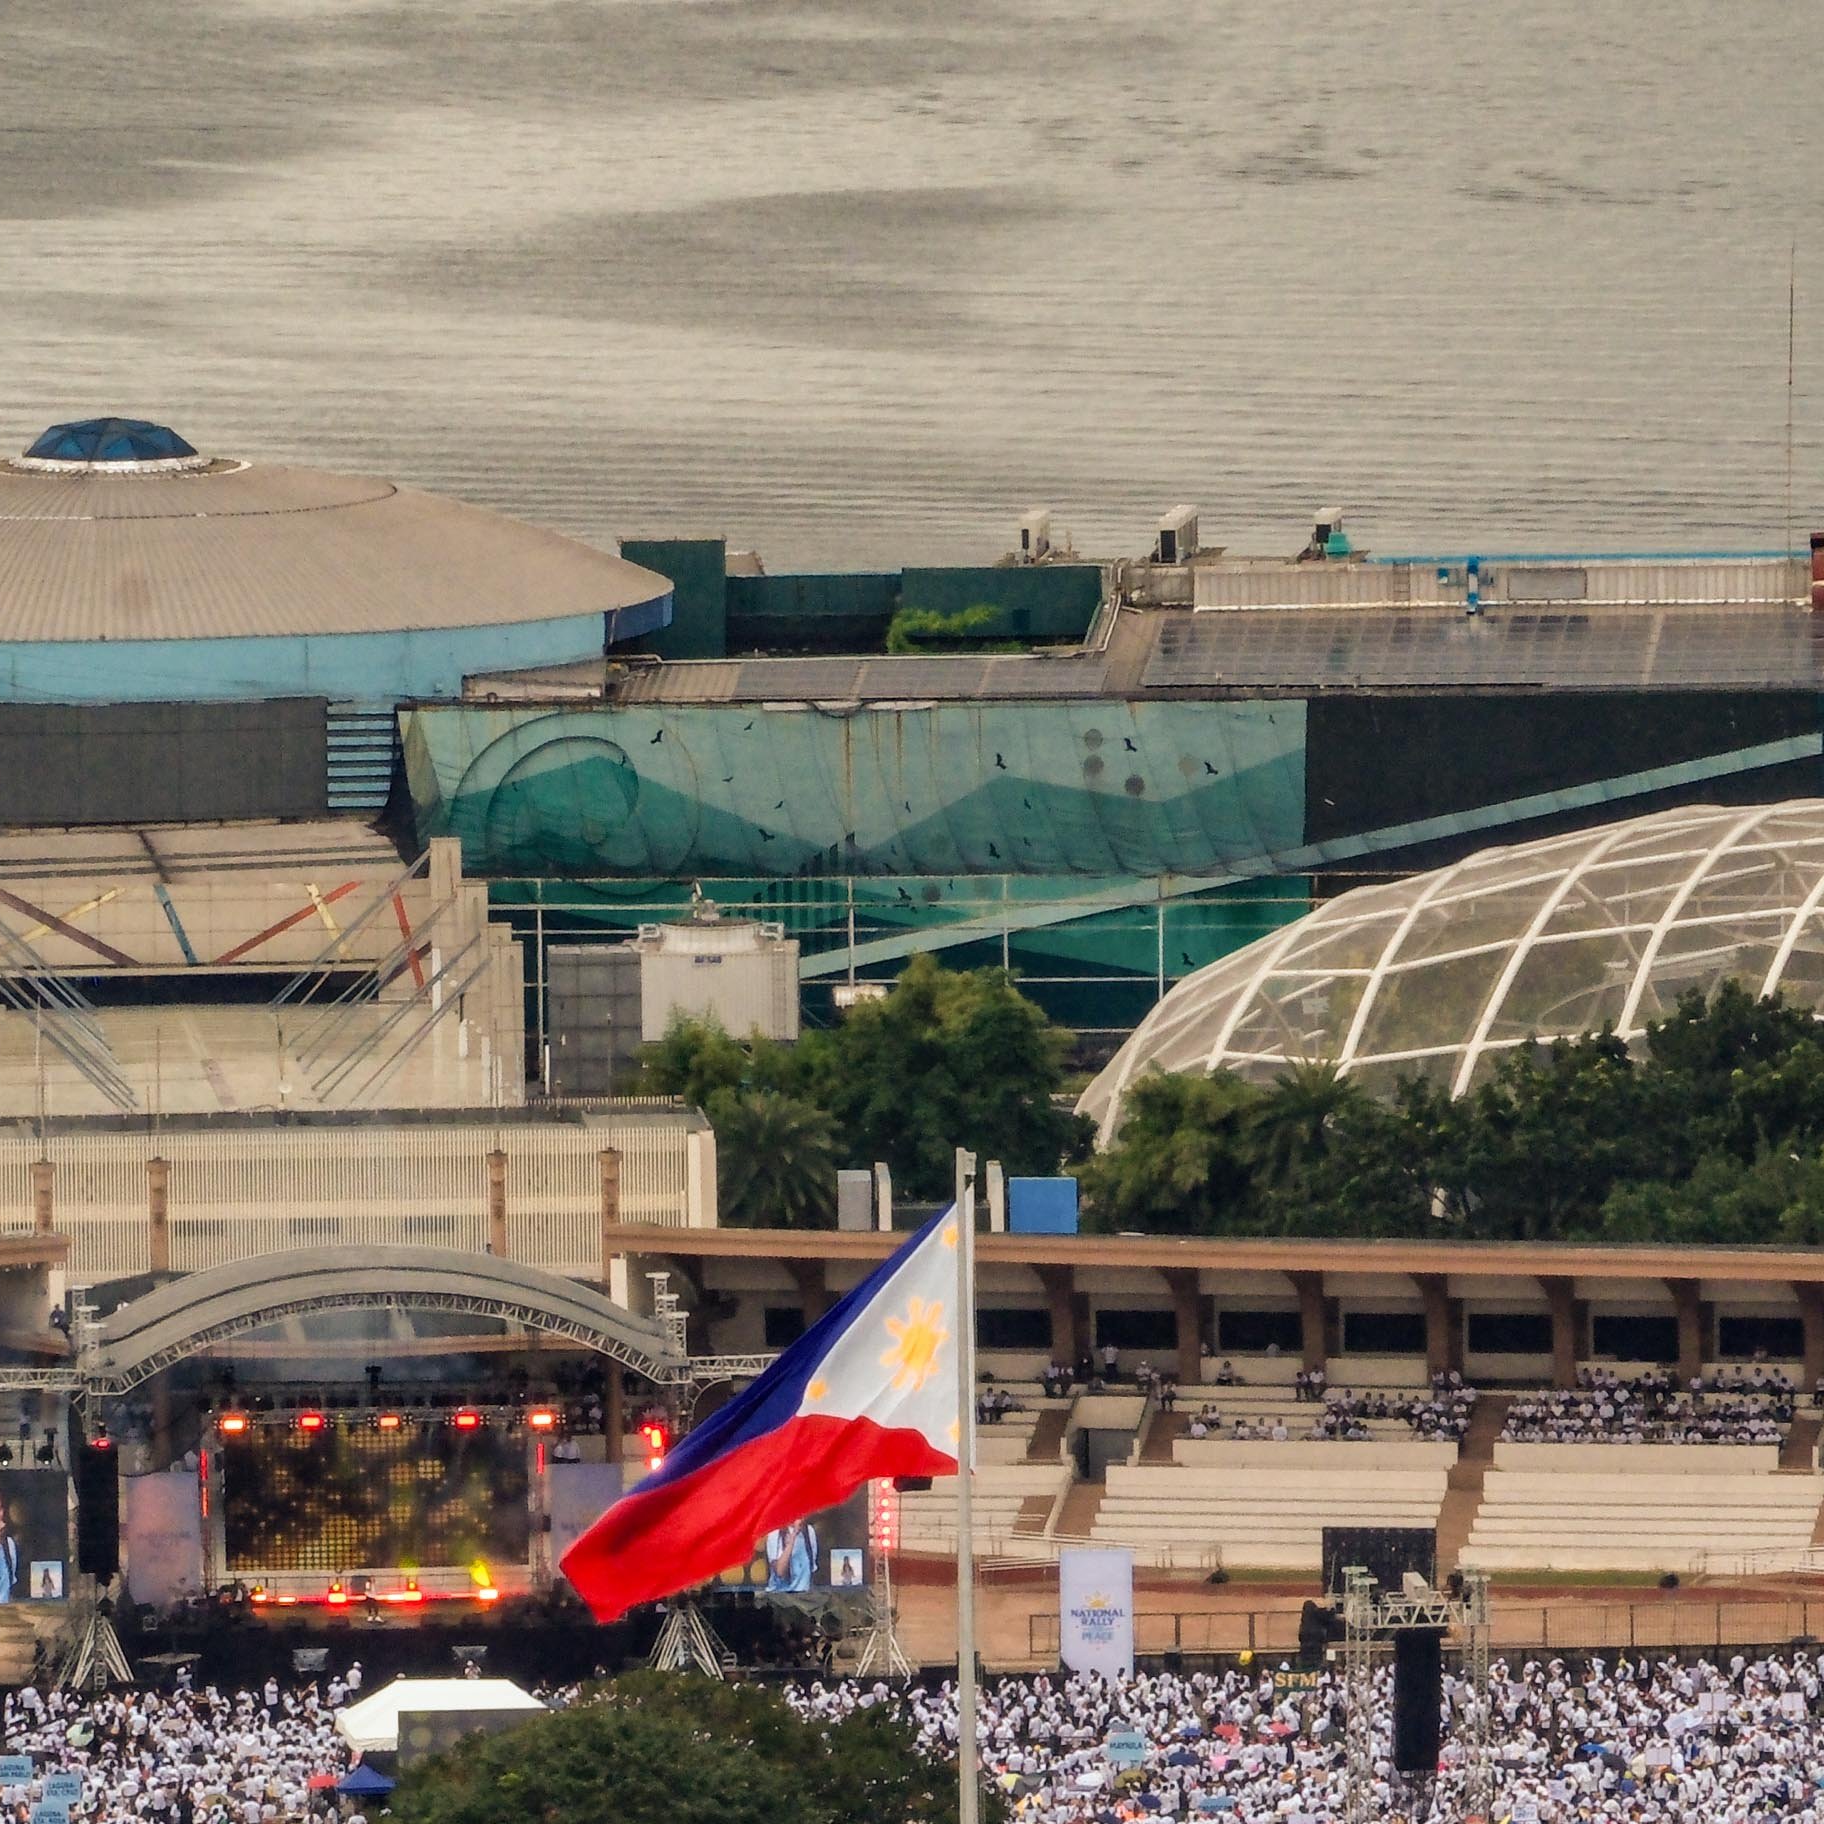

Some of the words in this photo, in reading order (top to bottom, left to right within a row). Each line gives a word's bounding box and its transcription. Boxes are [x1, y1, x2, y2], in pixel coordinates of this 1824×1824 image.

[1071, 1608, 1125, 1618] NATIONAL
[1081, 1617, 1115, 1626] RALLY
[1274, 1672, 1317, 1688] SFM
